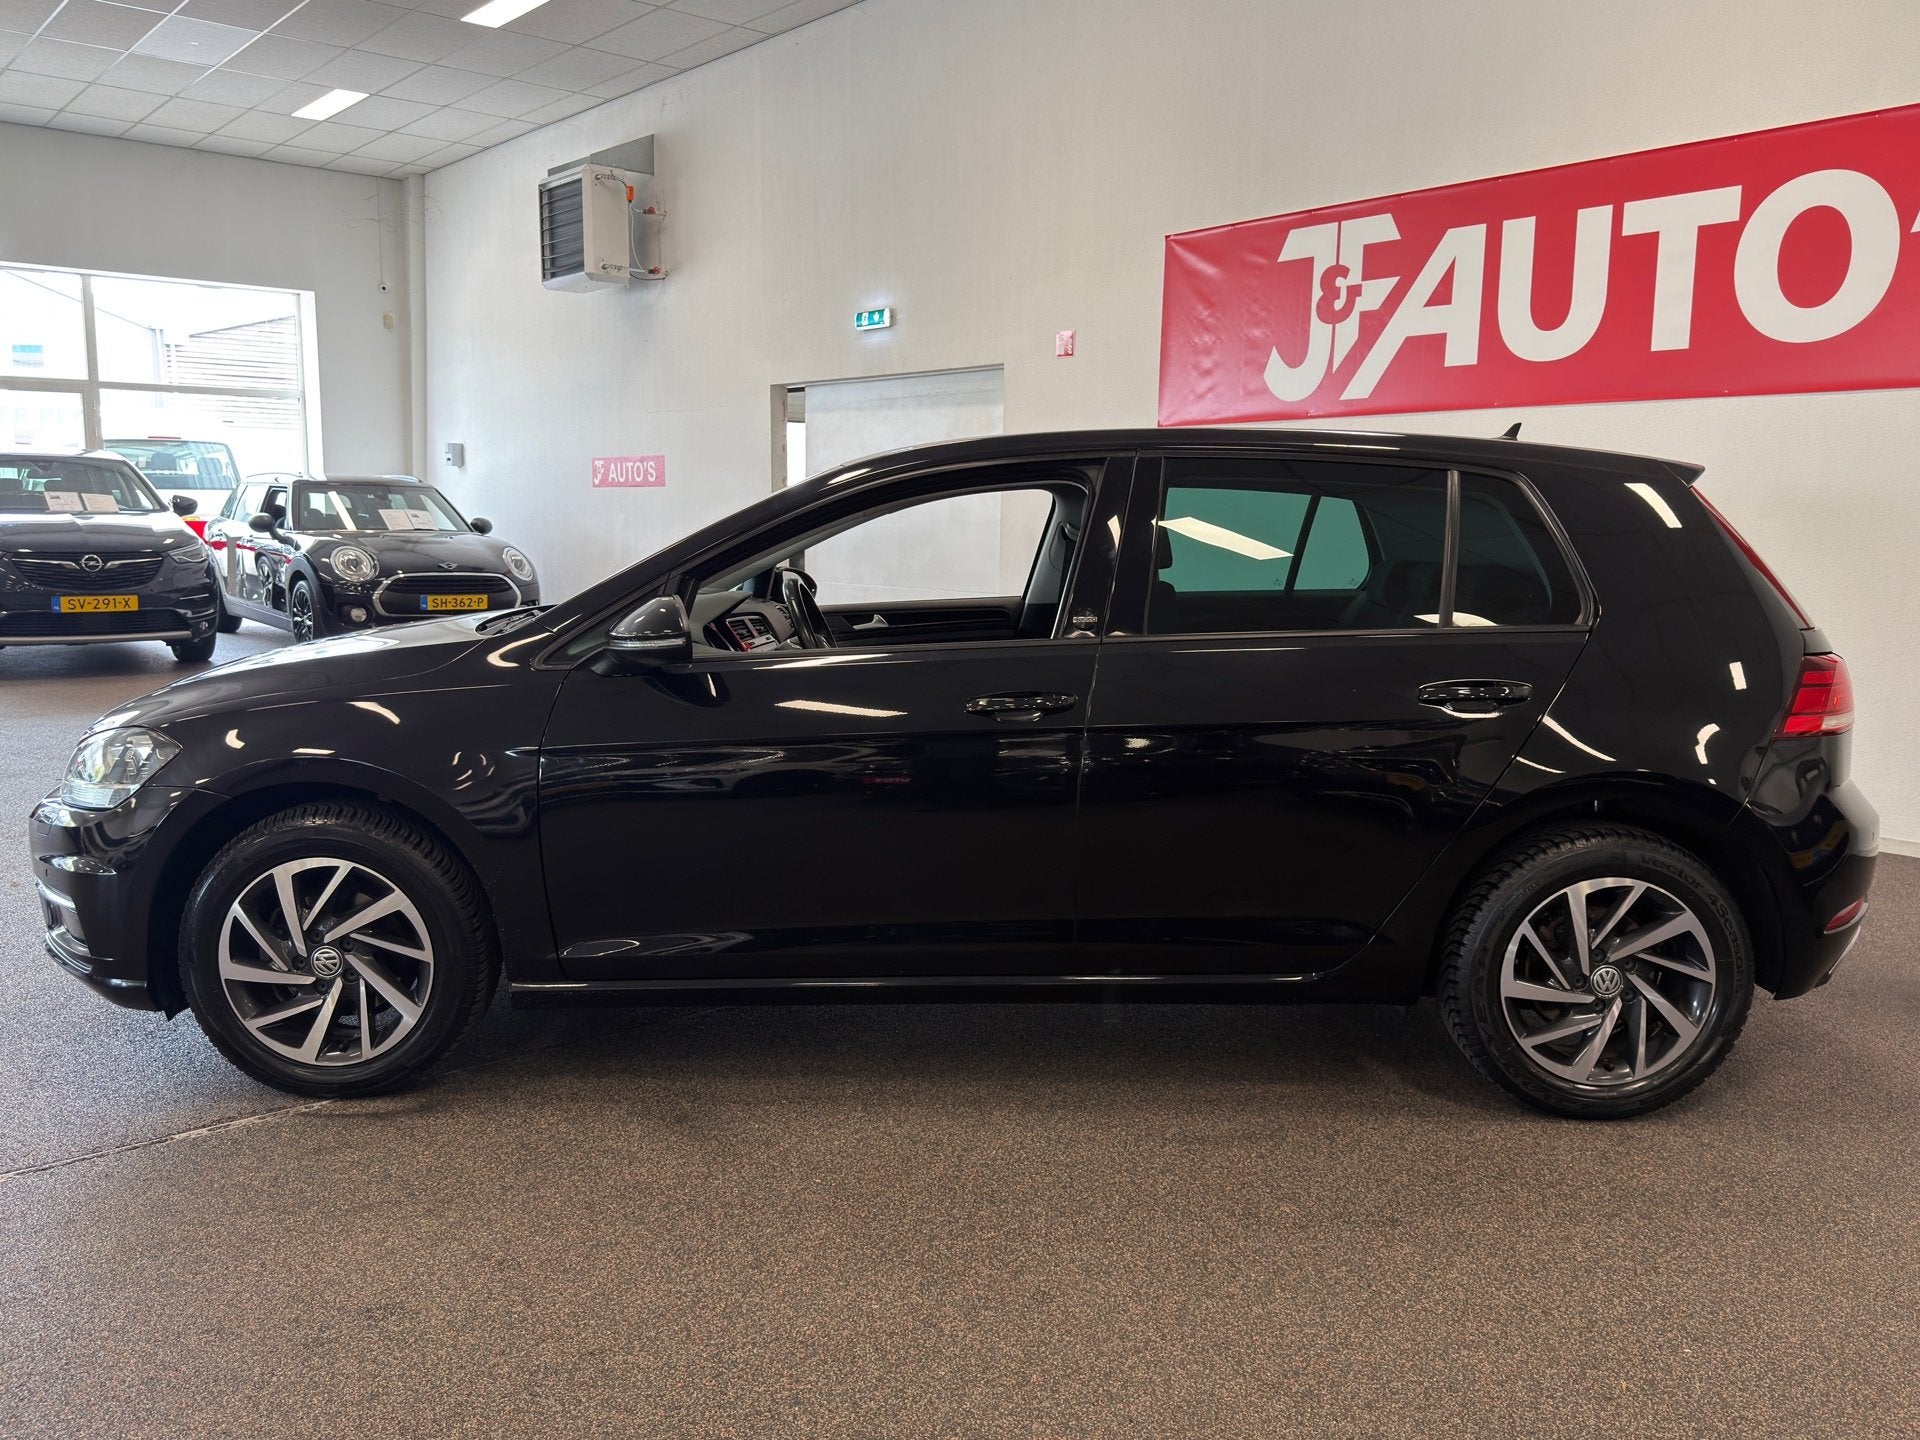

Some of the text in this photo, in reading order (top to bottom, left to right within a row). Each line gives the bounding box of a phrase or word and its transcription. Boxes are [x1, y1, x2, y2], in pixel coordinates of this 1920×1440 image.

[608, 461, 656, 482] AUTO'S
[68, 597, 131, 610] SV-291-X
[432, 597, 484, 608] SH-362-P
